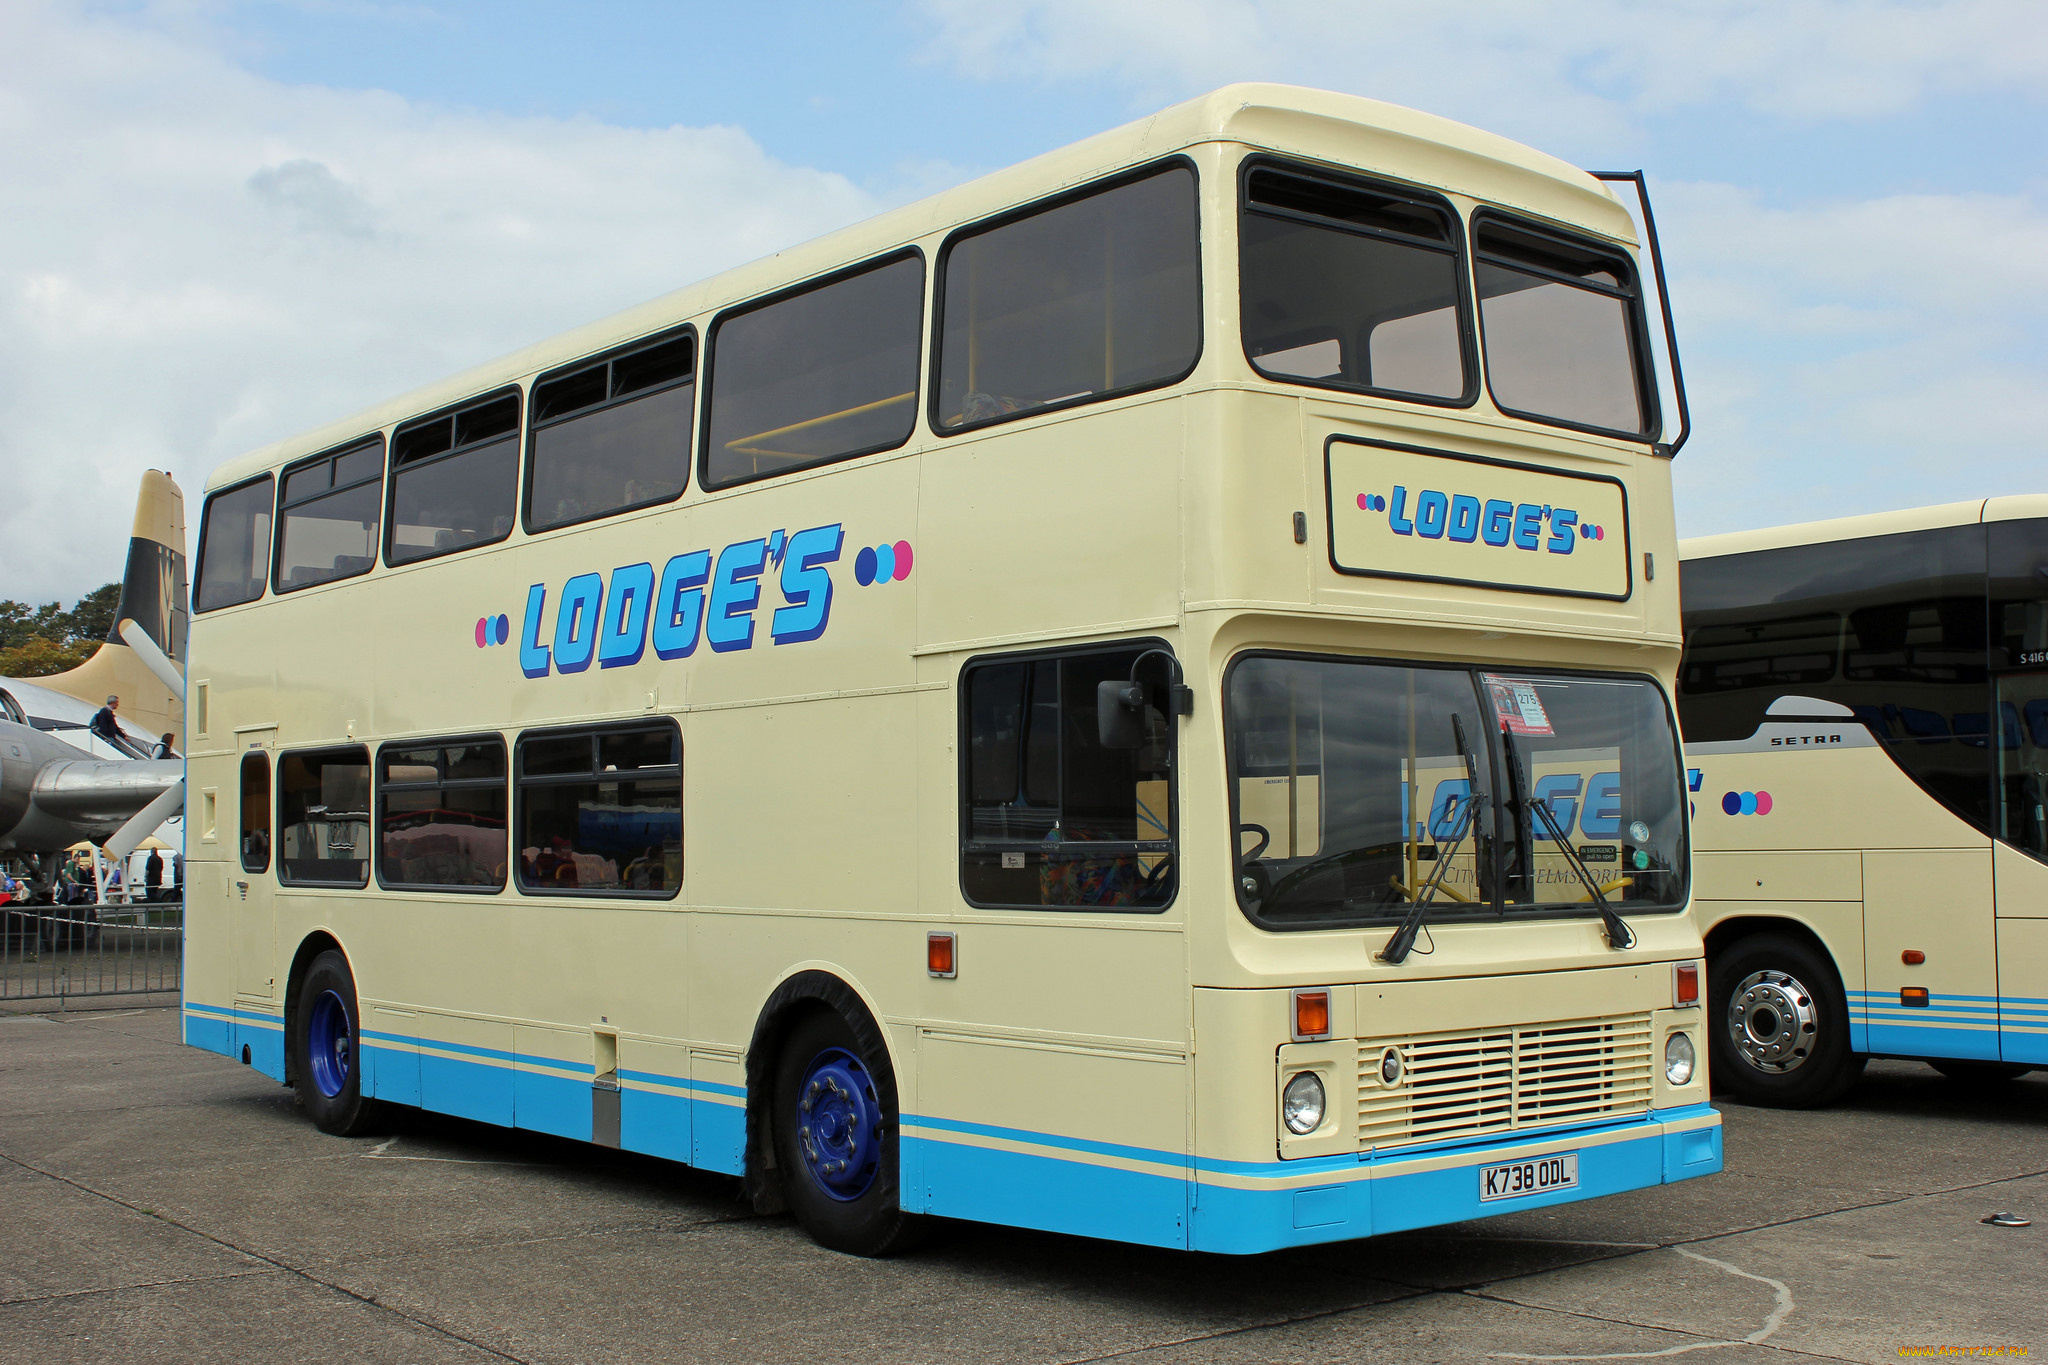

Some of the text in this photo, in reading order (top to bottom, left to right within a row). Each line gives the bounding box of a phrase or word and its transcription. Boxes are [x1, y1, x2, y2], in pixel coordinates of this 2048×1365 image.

[1388, 485, 1578, 555] LODGE'S
[519, 523, 845, 679] LODGE'S
[2020, 653, 2027, 664] S
[1517, 694, 1536, 705] 275
[1771, 735, 1841, 746] SETRA
[1487, 1159, 1571, 1195] K738 ODL
